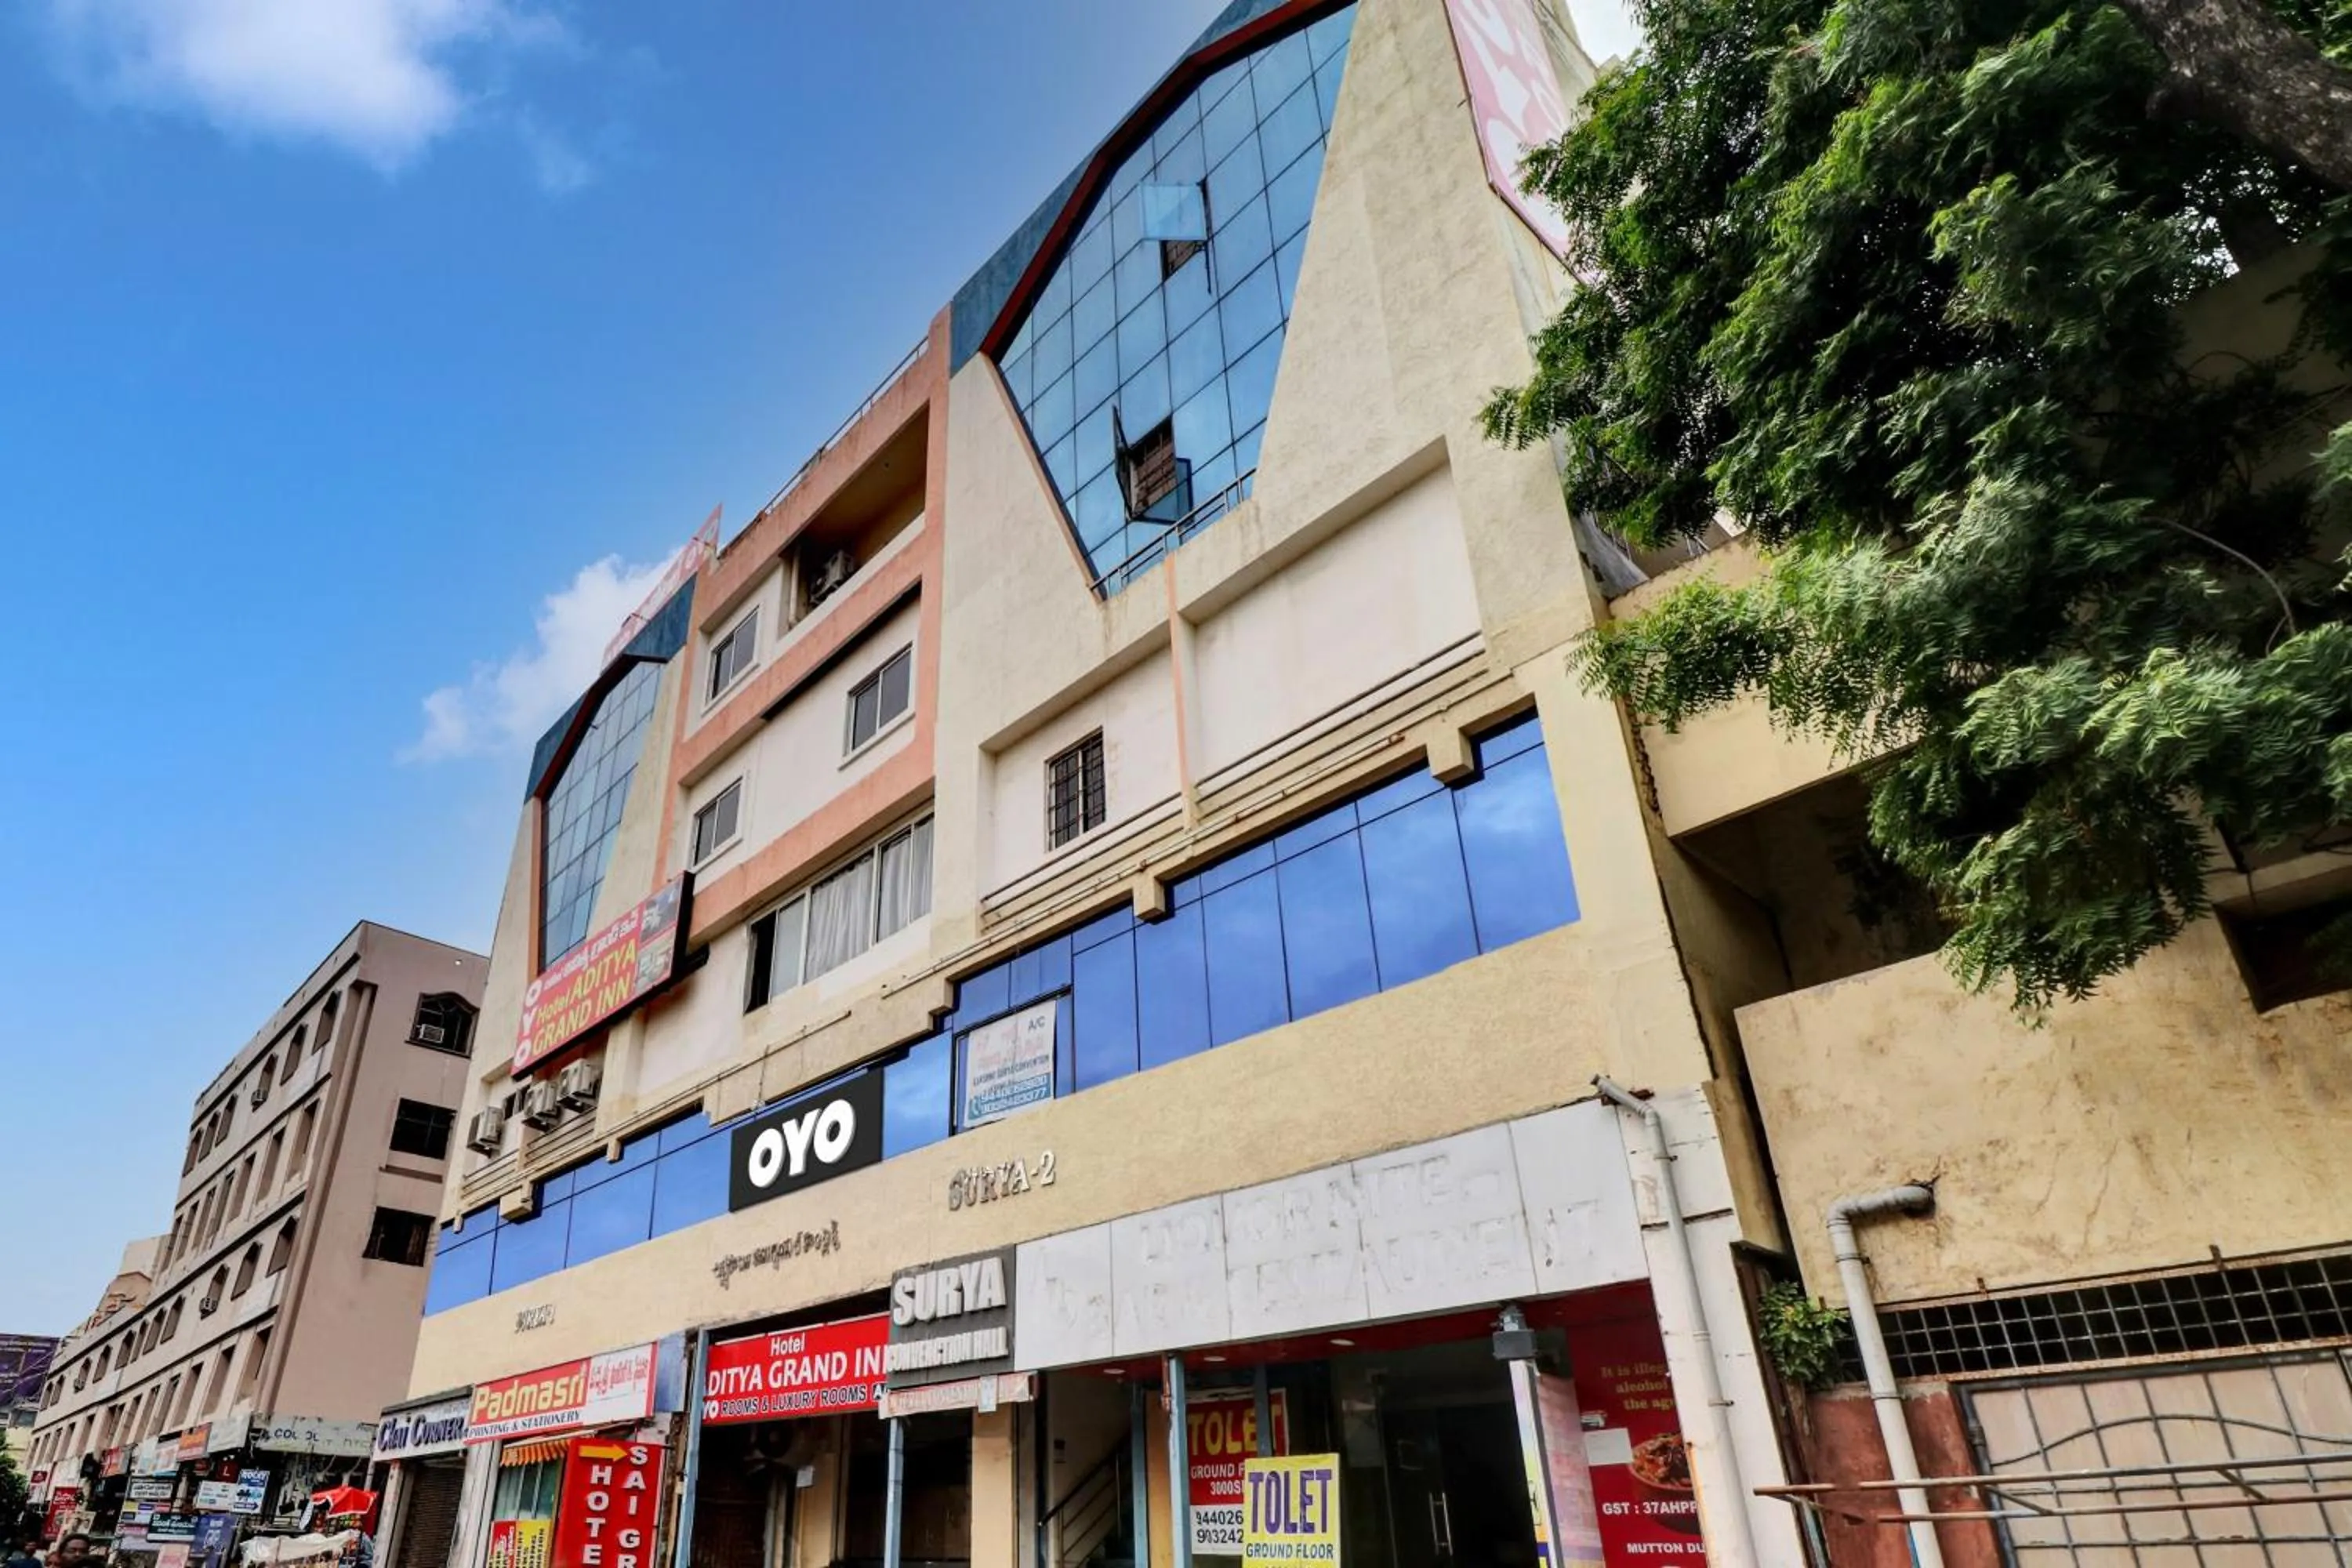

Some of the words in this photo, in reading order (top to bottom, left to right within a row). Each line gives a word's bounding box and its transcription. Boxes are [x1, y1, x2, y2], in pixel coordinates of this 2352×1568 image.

[569, 938, 637, 1005] ADITYA
[514, 979, 543, 1068] OYO
[532, 1000, 592, 1056] GRAND
[596, 972, 631, 1018] INN
[1027, 1015, 1046, 1033] A/C
[749, 1099, 856, 1189] OYO
[949, 1149, 1057, 1211] SURYA-2
[893, 1257, 1007, 1327] SURYA
[771, 1332, 806, 1357] Hotel
[973, 1326, 1009, 1360] HALL
[707, 1363, 763, 1396] DITYA
[768, 1350, 848, 1389] GRAND
[1600, 1367, 1615, 1378] It
[1617, 1365, 1630, 1377] is
[471, 1361, 588, 1423] Padmasri
[702, 1399, 720, 1421] YO
[720, 1396, 759, 1417] ROOMS
[771, 1389, 818, 1413] LUXURY
[820, 1383, 868, 1407] ROOMS
[1623, 1398, 1648, 1410] the
[470, 1420, 513, 1439] PRINTING
[521, 1410, 581, 1429] STATIONERY
[622, 1445, 648, 1516] SAI
[1191, 1463, 1236, 1479] GROUND
[1248, 1469, 1332, 1534] TOLET
[1602, 1501, 1630, 1515] GST
[1246, 1542, 1293, 1558] GROUND
[1296, 1543, 1334, 1559] FLOOR
[1627, 1542, 1684, 1554] MUTTON
